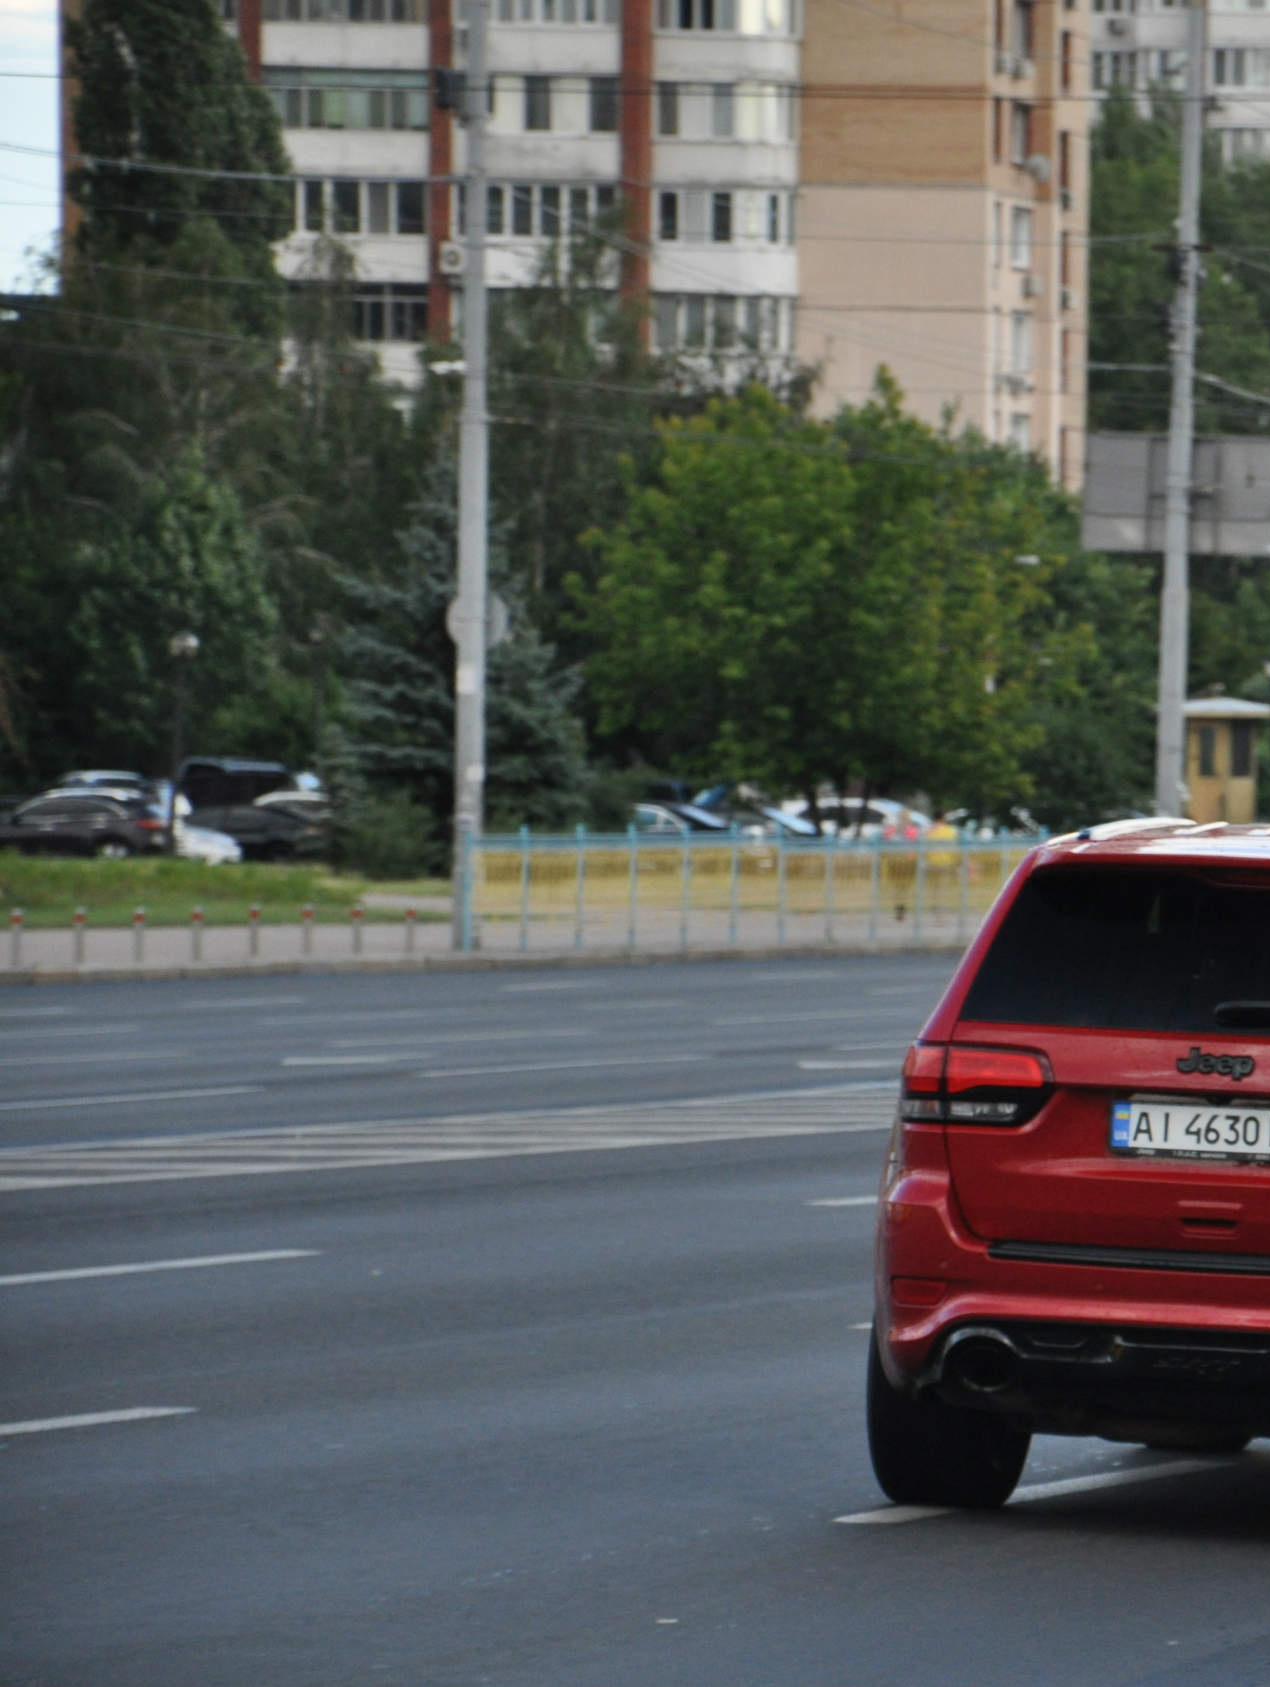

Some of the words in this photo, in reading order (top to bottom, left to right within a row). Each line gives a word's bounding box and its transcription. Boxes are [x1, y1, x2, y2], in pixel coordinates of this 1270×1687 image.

[1176, 1047, 1256, 1081] Jeep
[1114, 1130, 1128, 1141] UA
[1133, 1112, 1170, 1142] AI
[1185, 1114, 1260, 1146] 4630
